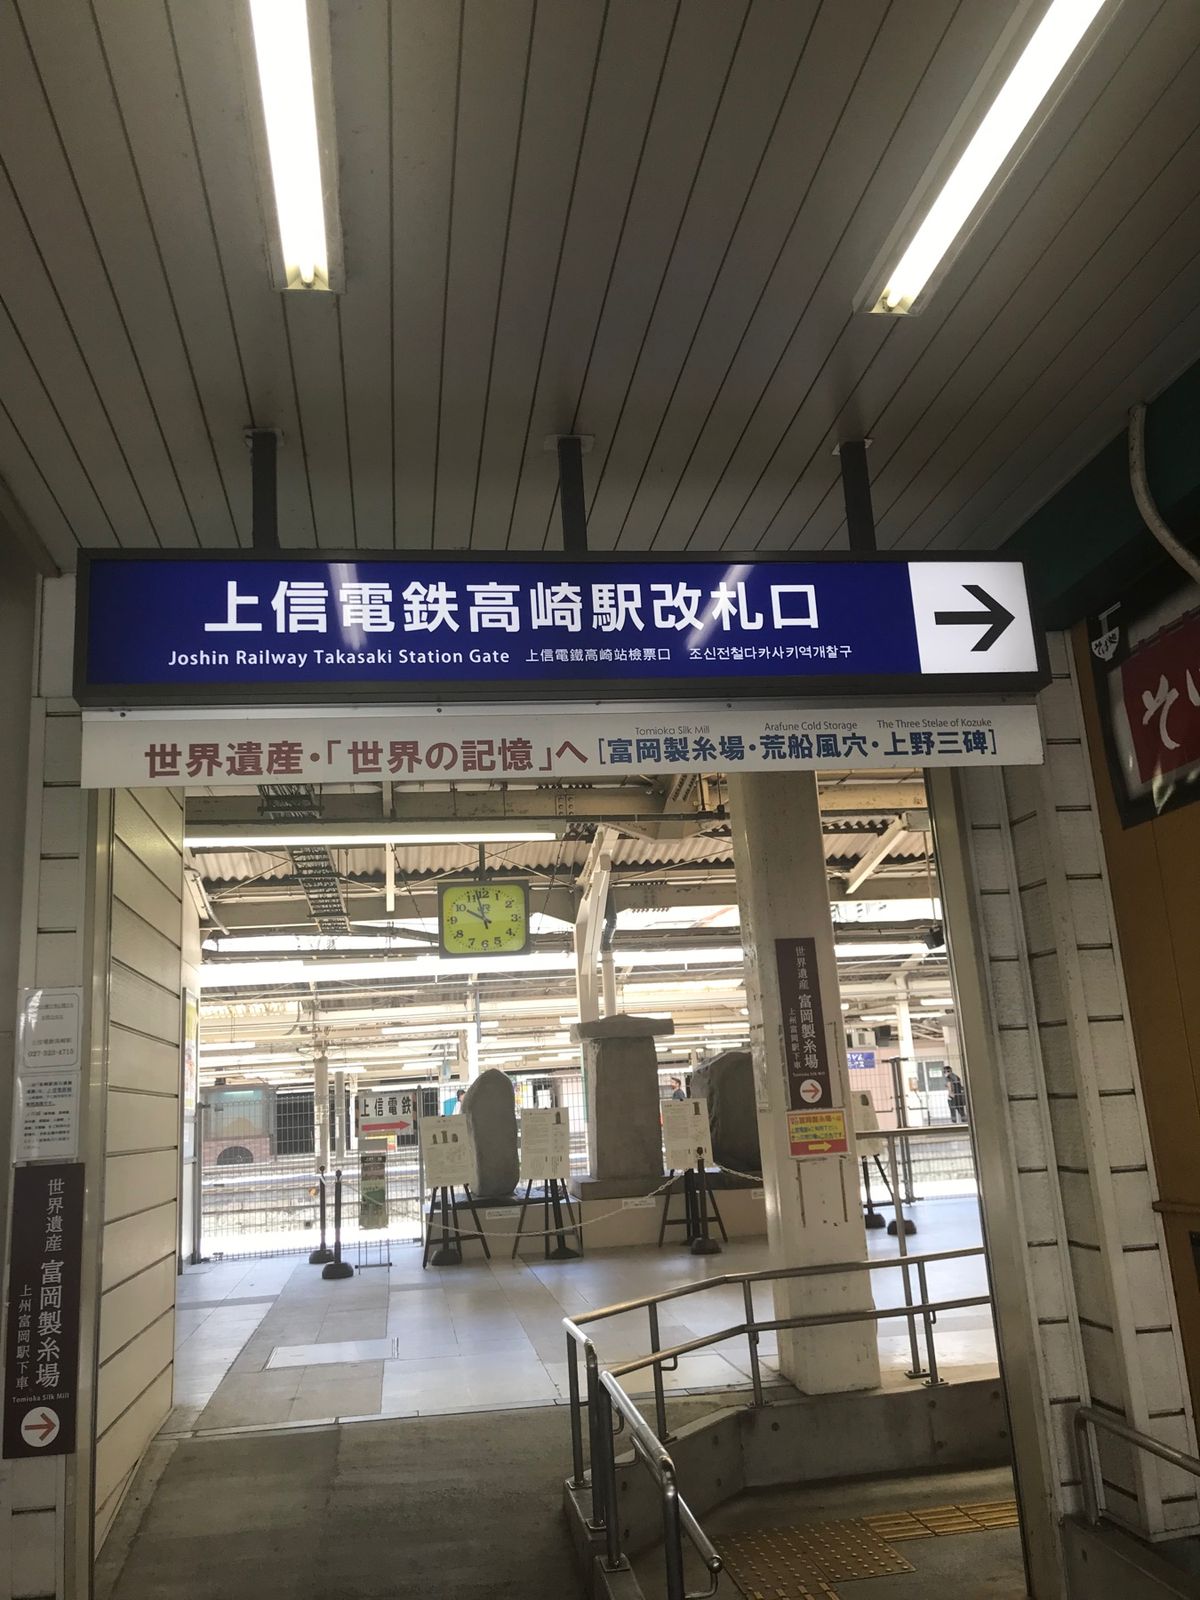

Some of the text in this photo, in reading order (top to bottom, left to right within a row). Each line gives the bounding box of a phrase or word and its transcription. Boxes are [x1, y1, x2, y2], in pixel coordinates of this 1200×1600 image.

[204, 580, 819, 633] 上信電鉄高崎駅改札口
[168, 648, 510, 668] Joshin Railway Takasaki Station Gate
[689, 644, 853, 661] 조신전철다카사키역개찰구
[764, 720, 858, 732] Arafune Cold Storage
[877, 717, 992, 729] The Three Stelae of Kozuke
[635, 725, 710, 736] Tomioka Silk Mill
[455, 904, 467, 912] 10
[505, 900, 512, 908] 2
[450, 916, 457, 924] 9
[511, 914, 518, 922] 3
[456, 930, 464, 938] 8
[505, 928, 512, 936] 4
[468, 938, 475, 946] 7
[481, 939, 489, 948] 6
[494, 936, 501, 945] 5
[795, 945, 809, 990] 世界遺産
[798, 993, 819, 1070] 富岡製糸場
[360, 1096, 412, 1117] 上信電鉄
[44, 1177, 65, 1253] 世界遺産
[35, 1259, 65, 1389] 富岡製糸場
[15, 1283, 33, 1390] 上州富岡駅下車
[41, 1393, 55, 1401] Silk
[56, 1392, 70, 1400] Mill
